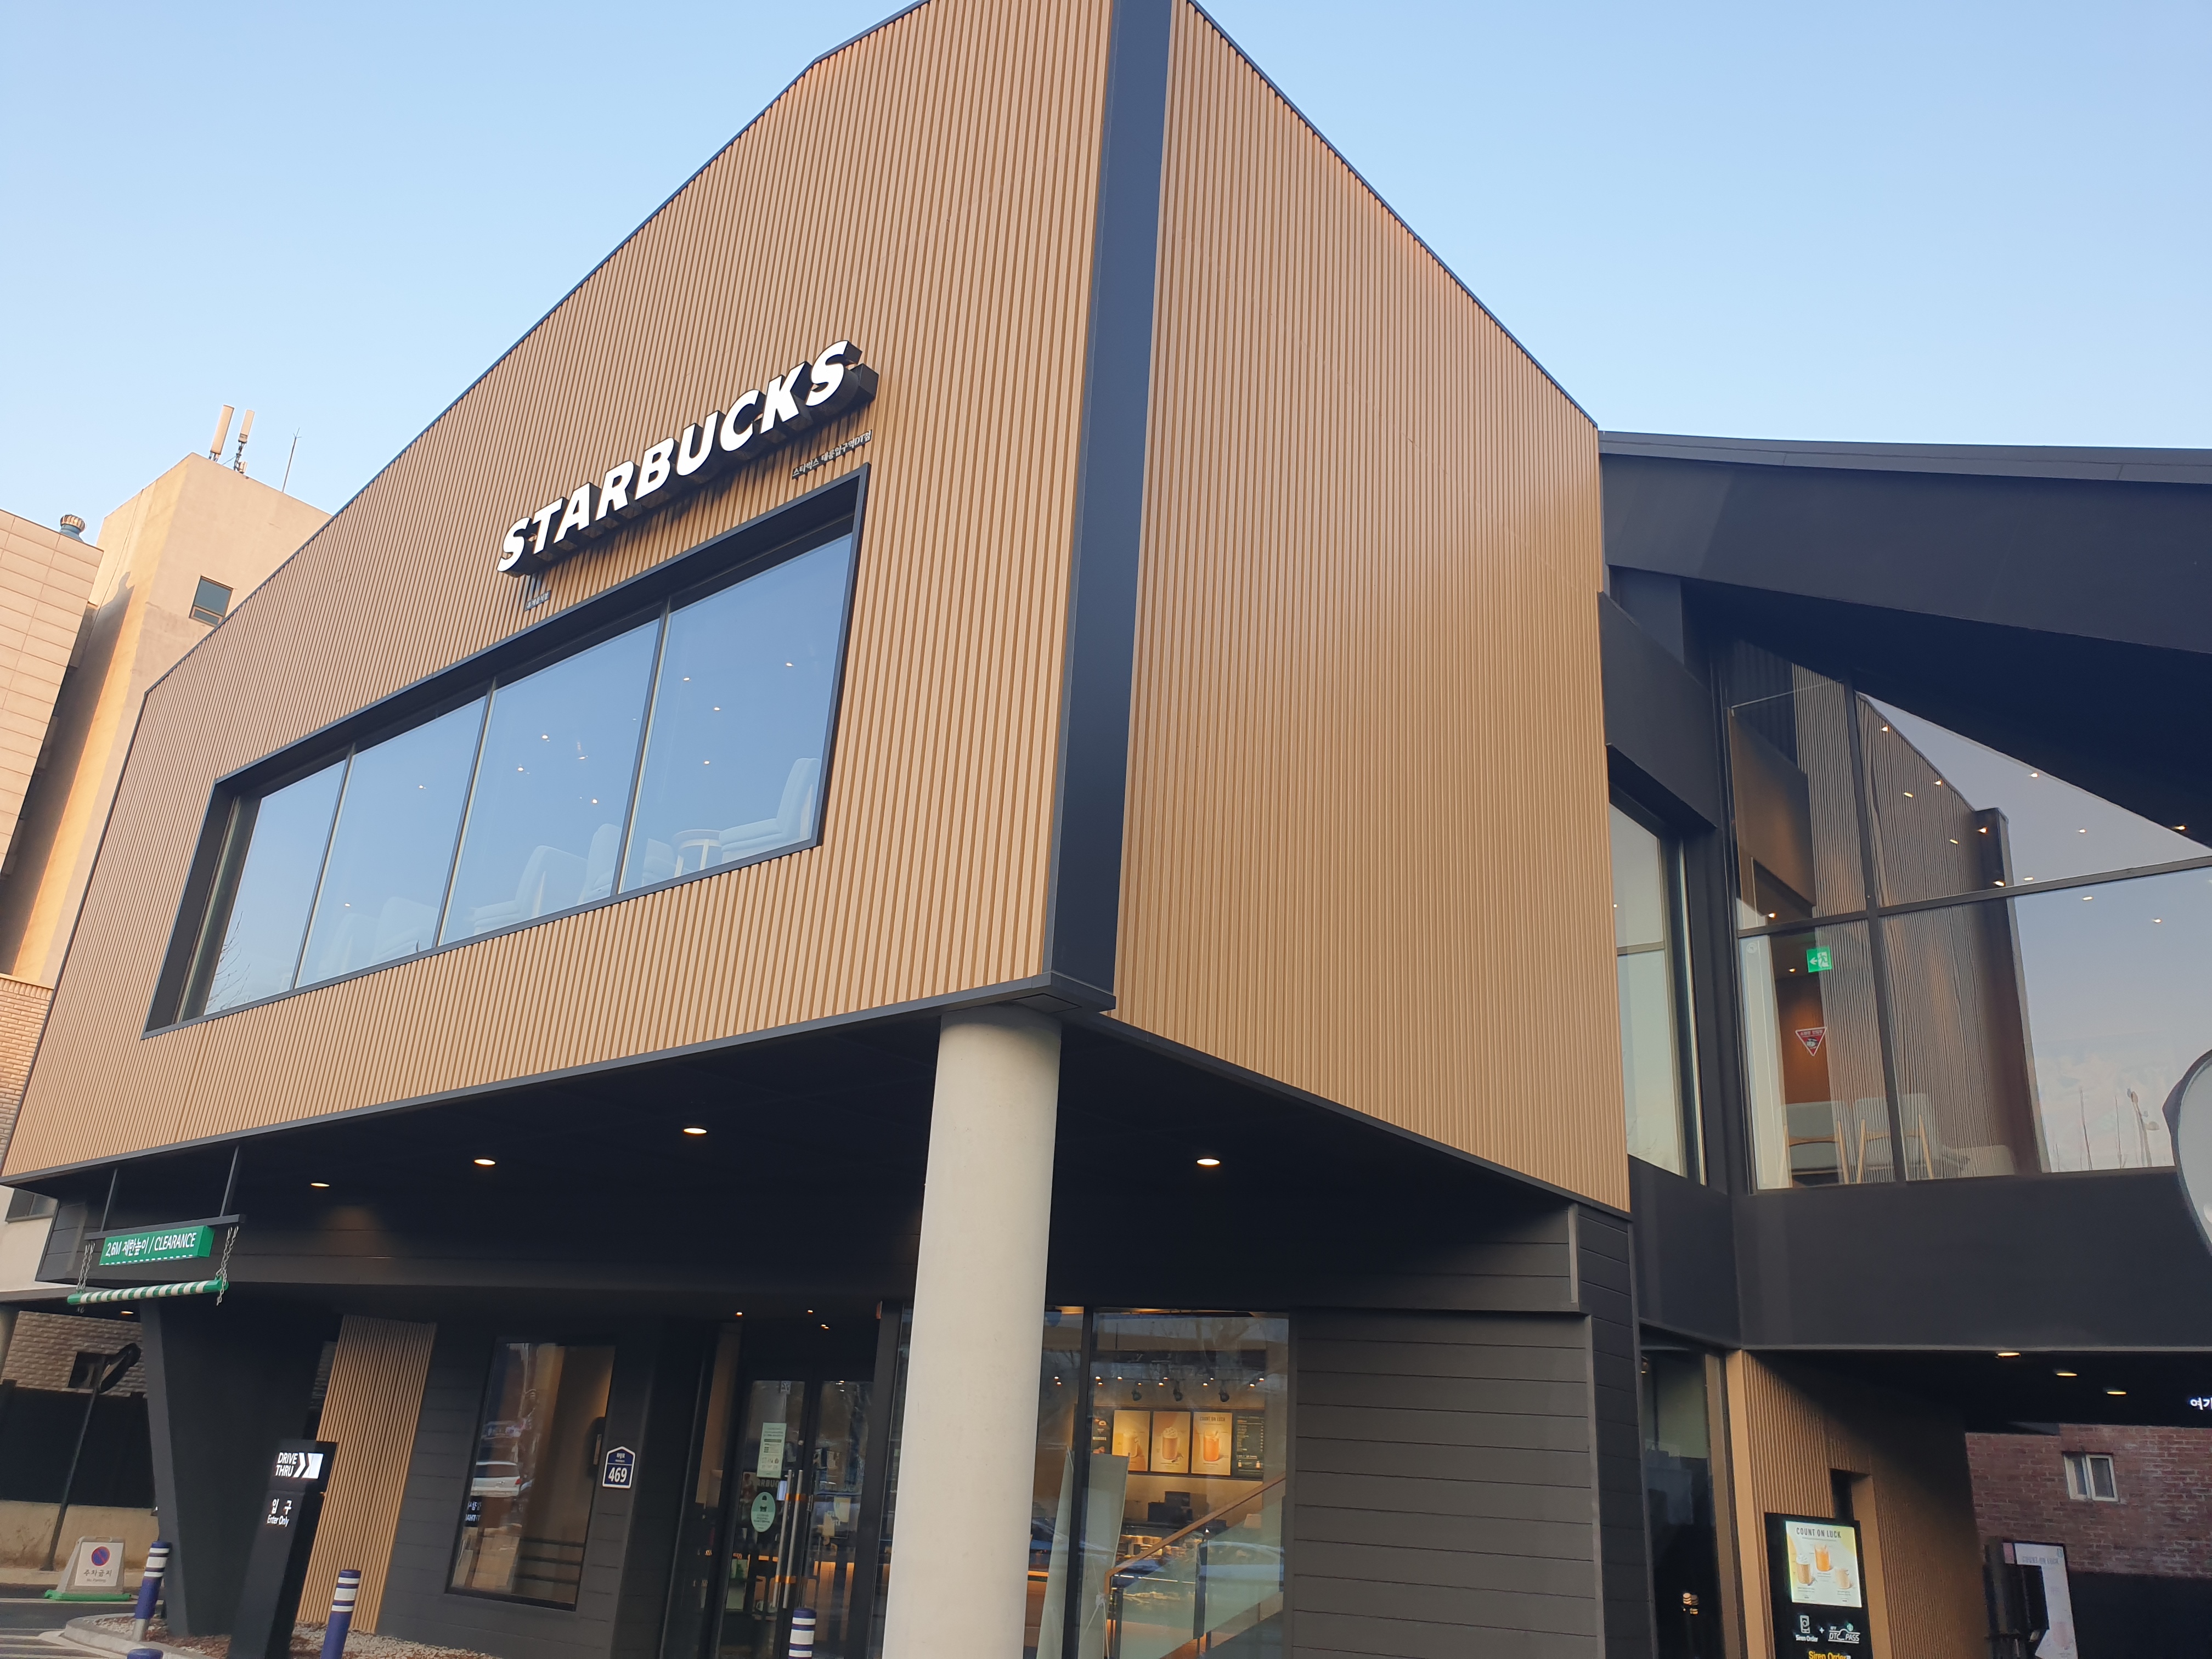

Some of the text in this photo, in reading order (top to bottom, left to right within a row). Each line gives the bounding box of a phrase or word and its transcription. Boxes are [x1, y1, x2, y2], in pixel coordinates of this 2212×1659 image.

[496, 340, 850, 572] STARBUCKS
[792, 458, 819, 477] 스타벅스
[122, 1237, 150, 1256] 제한높이
[154, 1232, 197, 1251] CLEARANCE
[278, 1452, 298, 1464] DRIVE
[275, 1465, 294, 1477] THRU
[608, 1467, 628, 1483] 469
[267, 1514, 289, 1527] Enter Only
[1796, 1527, 1815, 1536] COUNT
[1826, 1530, 1842, 1538] LUCK
[1846, 1633, 1860, 1642] PASS
